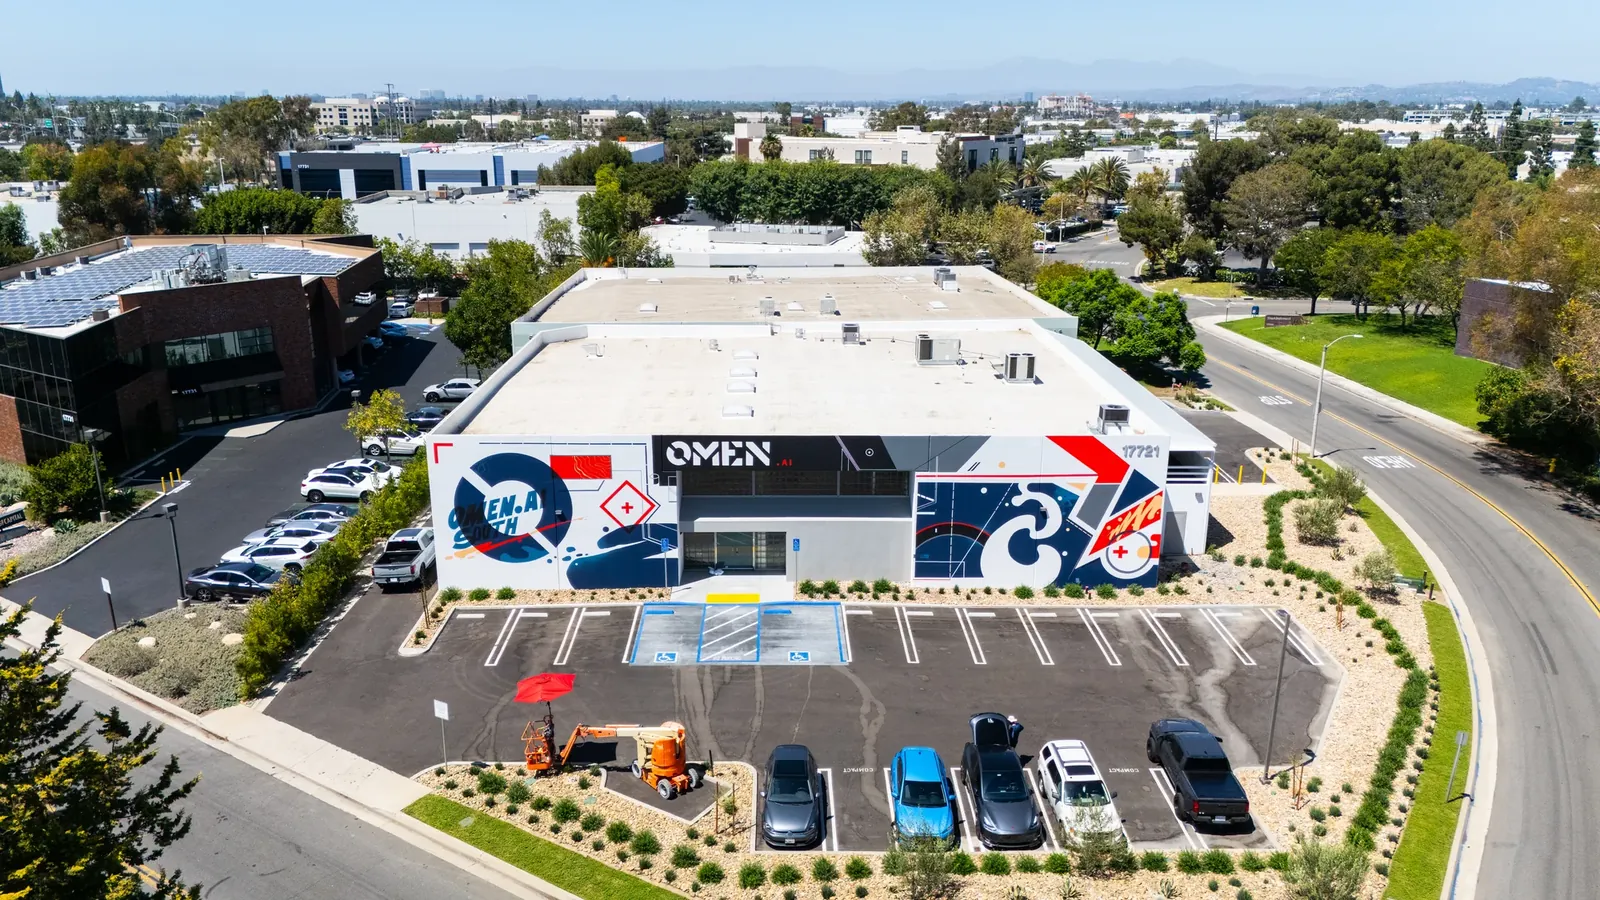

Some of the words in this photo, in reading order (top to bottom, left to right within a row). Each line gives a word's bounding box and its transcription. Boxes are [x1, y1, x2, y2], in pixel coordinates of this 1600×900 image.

[1258, 395, 1293, 405] STOP
[666, 440, 771, 467] OMEN
[1122, 444, 1160, 458] 17721
[1362, 455, 1417, 469] AHEAD
[447, 488, 547, 531] OMEN.AI
[452, 516, 519, 550] SOUTH
